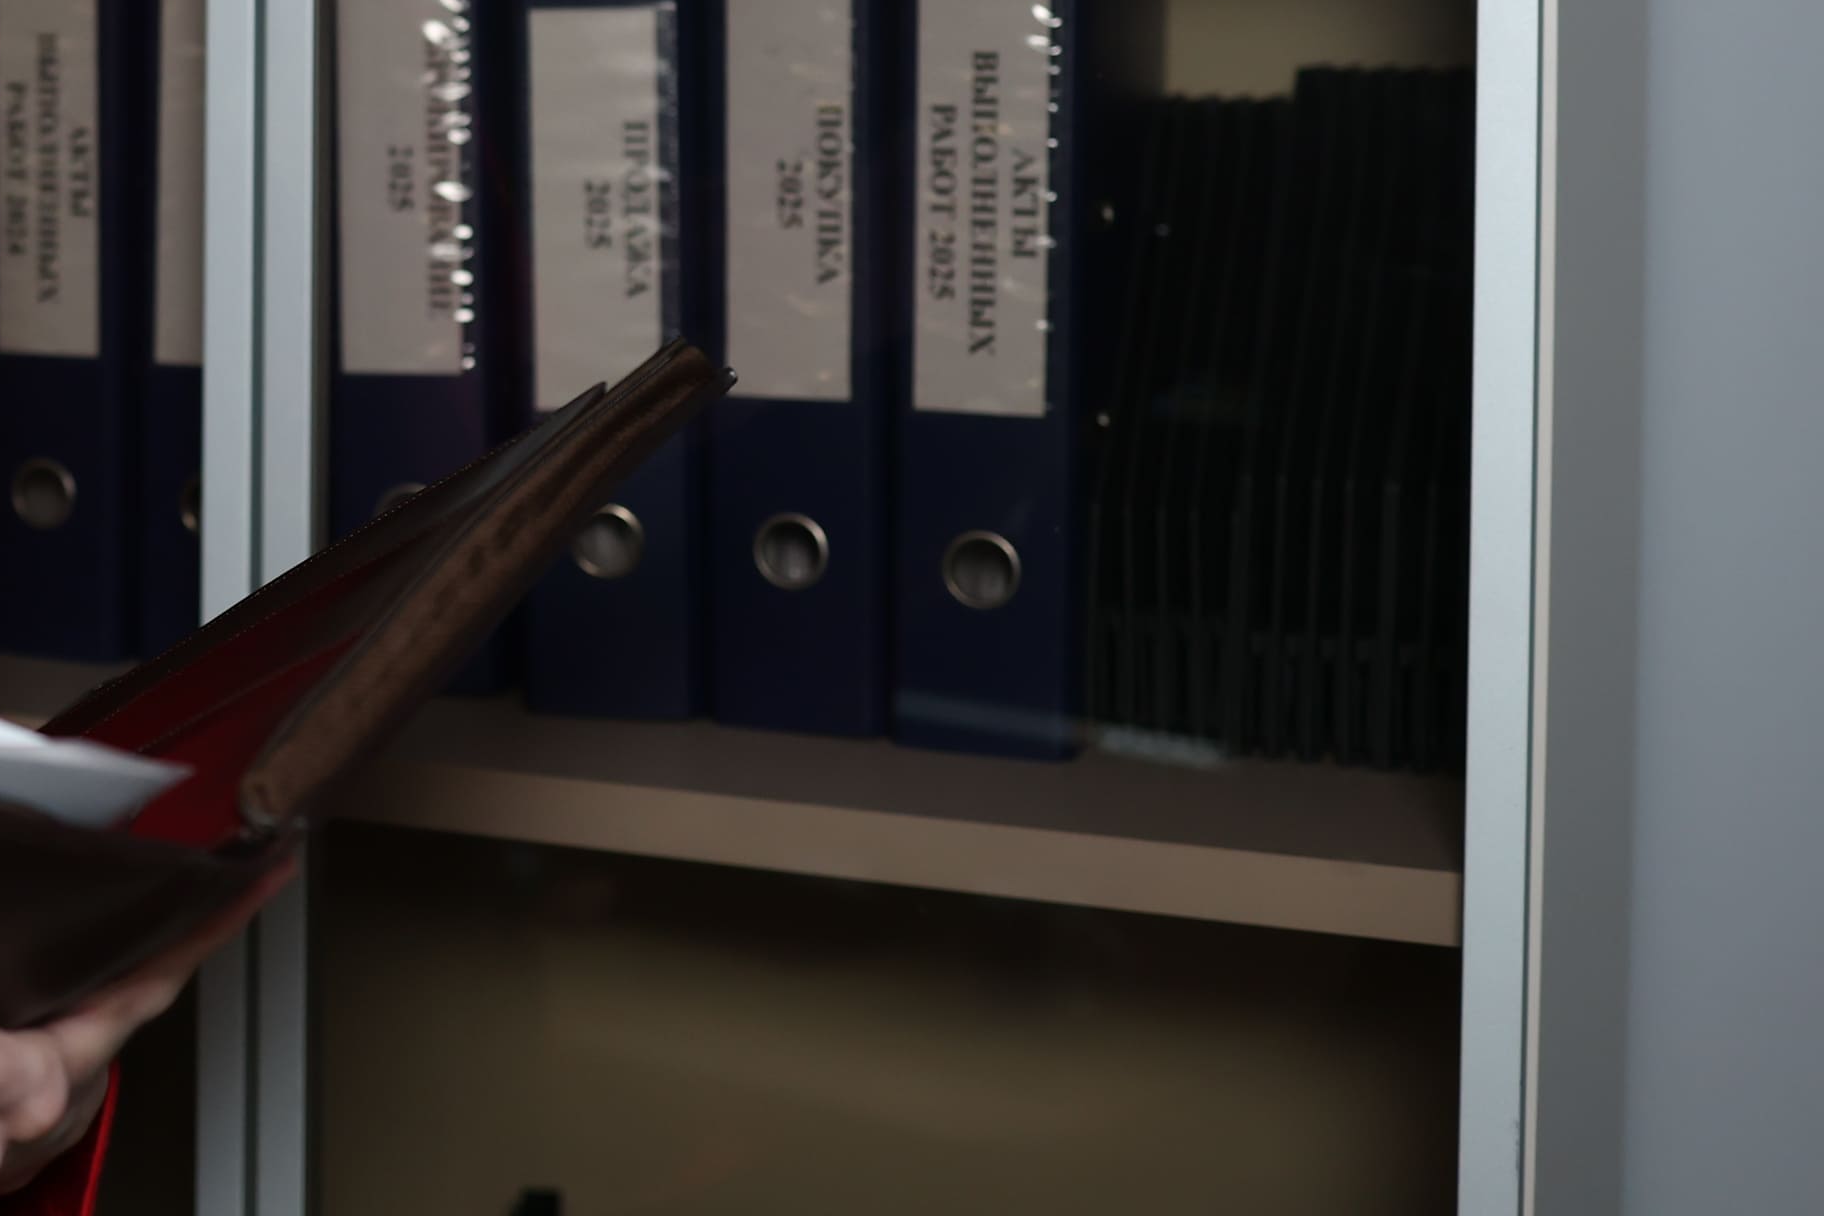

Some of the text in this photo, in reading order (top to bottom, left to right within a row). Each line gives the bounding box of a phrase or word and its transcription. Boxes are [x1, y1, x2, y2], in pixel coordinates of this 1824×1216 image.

[388, 145, 415, 213] 2025
[584, 180, 612, 251] 2025
[623, 121, 651, 299] ПРОДАЖА
[777, 159, 804, 231] 2025
[816, 105, 845, 285] ПОКУПКА
[929, 104, 957, 301] РАБОТ 2025
[969, 51, 999, 356] ВЫПОЛНЕННЫХ
[1012, 150, 1039, 259] АКТЫ
